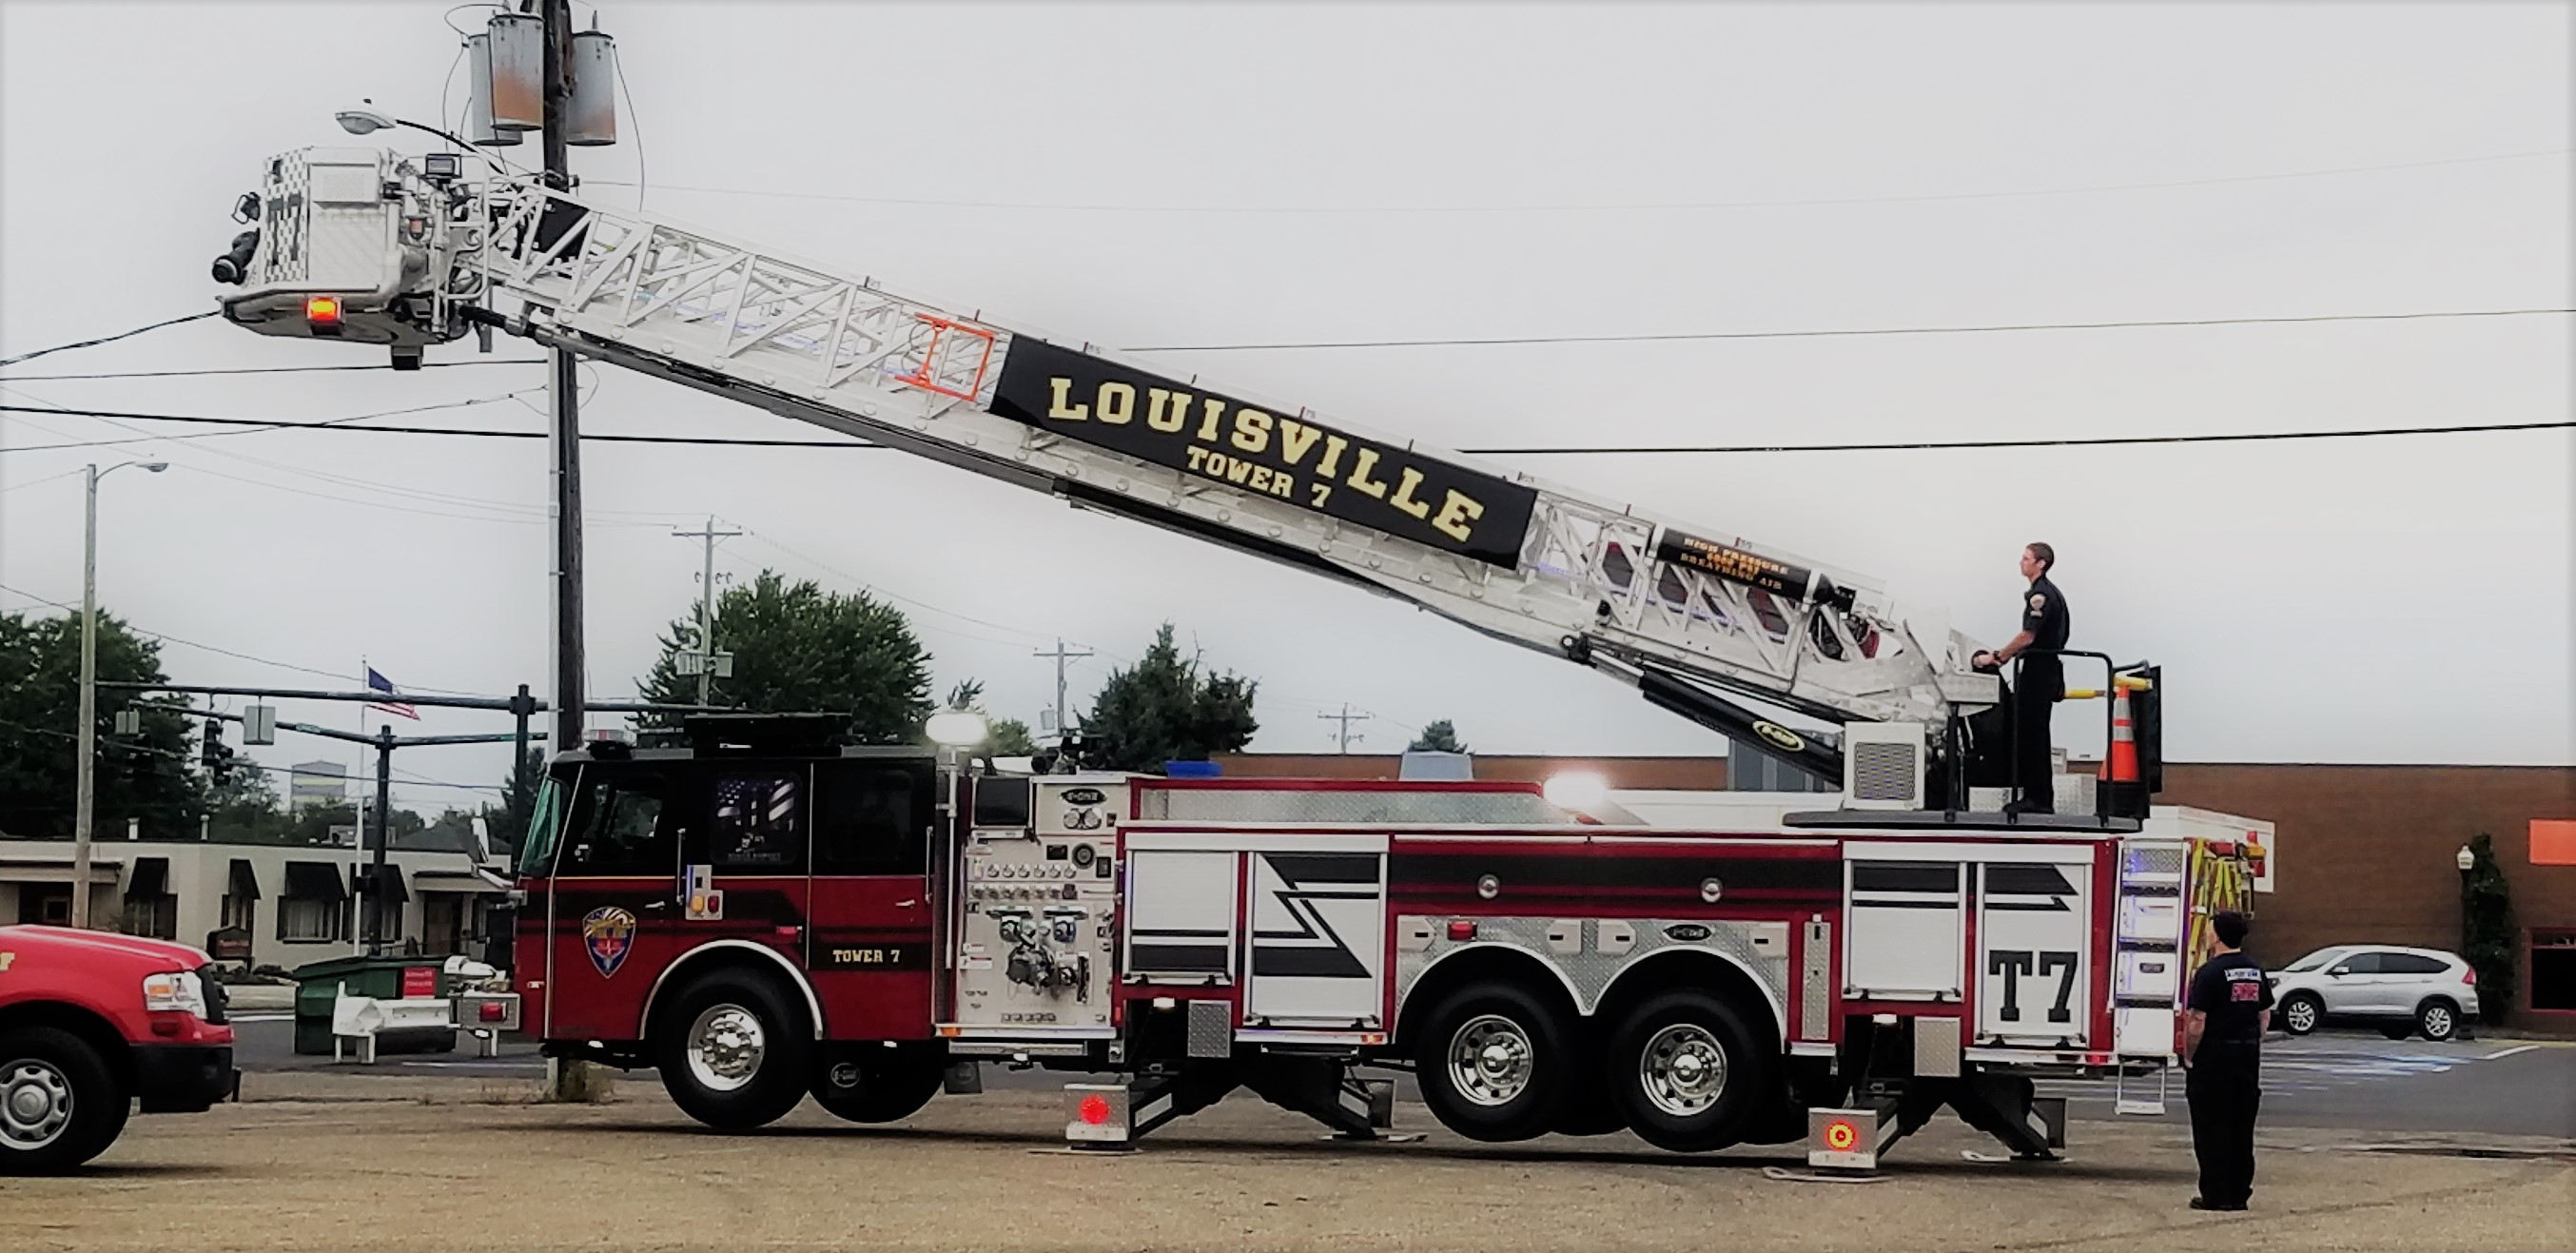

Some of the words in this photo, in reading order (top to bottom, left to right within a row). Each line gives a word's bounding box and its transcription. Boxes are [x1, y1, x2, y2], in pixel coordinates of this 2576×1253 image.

[1048, 377, 1486, 542] LOUISVILLE
[1185, 444, 1295, 499] TOWER
[1311, 482, 1333, 509] 7
[1760, 577, 1783, 591] AIR
[832, 949, 884, 963] TOWER
[889, 949, 901, 963] 7
[1988, 950, 2078, 1023] T7
